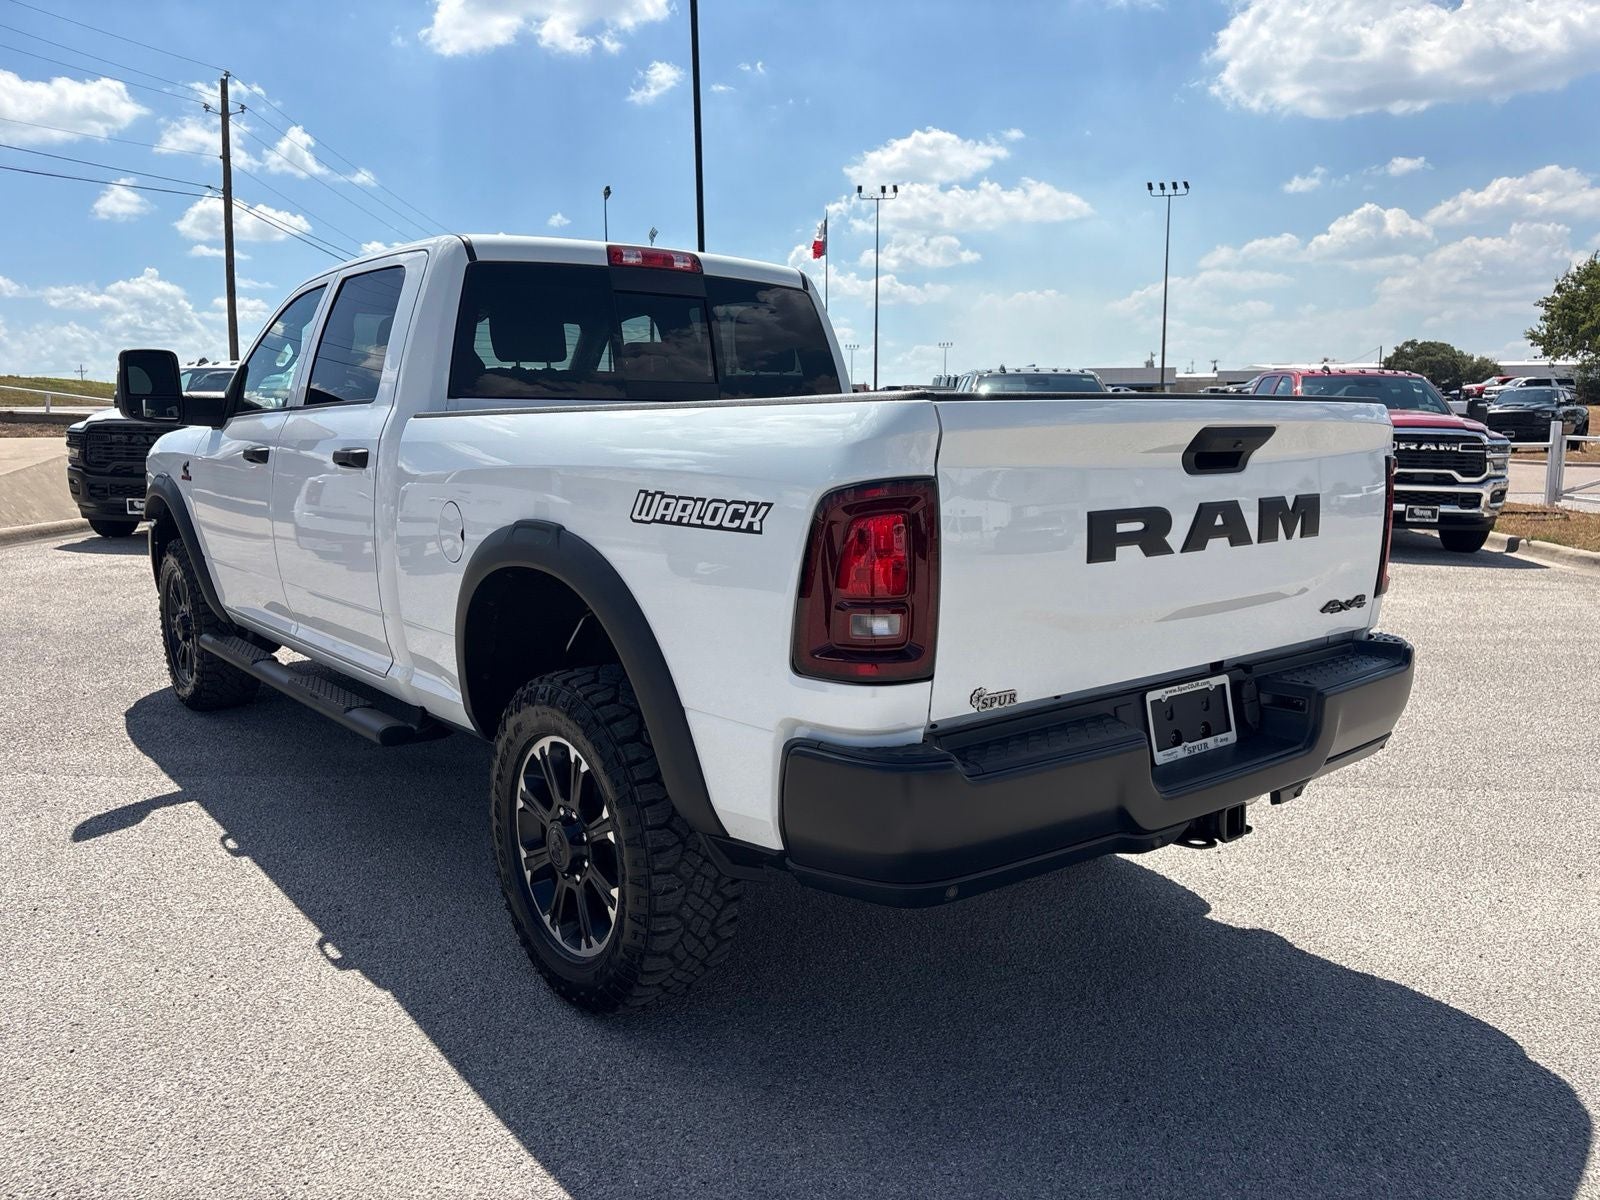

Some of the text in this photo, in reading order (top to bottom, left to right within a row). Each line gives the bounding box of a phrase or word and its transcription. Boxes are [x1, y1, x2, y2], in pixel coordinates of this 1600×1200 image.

[1399, 442, 1458, 451] RAM
[630, 489, 774, 535] WARLOCK
[1086, 493, 1320, 564] RAM
[1164, 680, 1211, 695] www.SpurCDJR.com
[981, 692, 1017, 709] SPUR
[1187, 742, 1209, 755] SPUR
